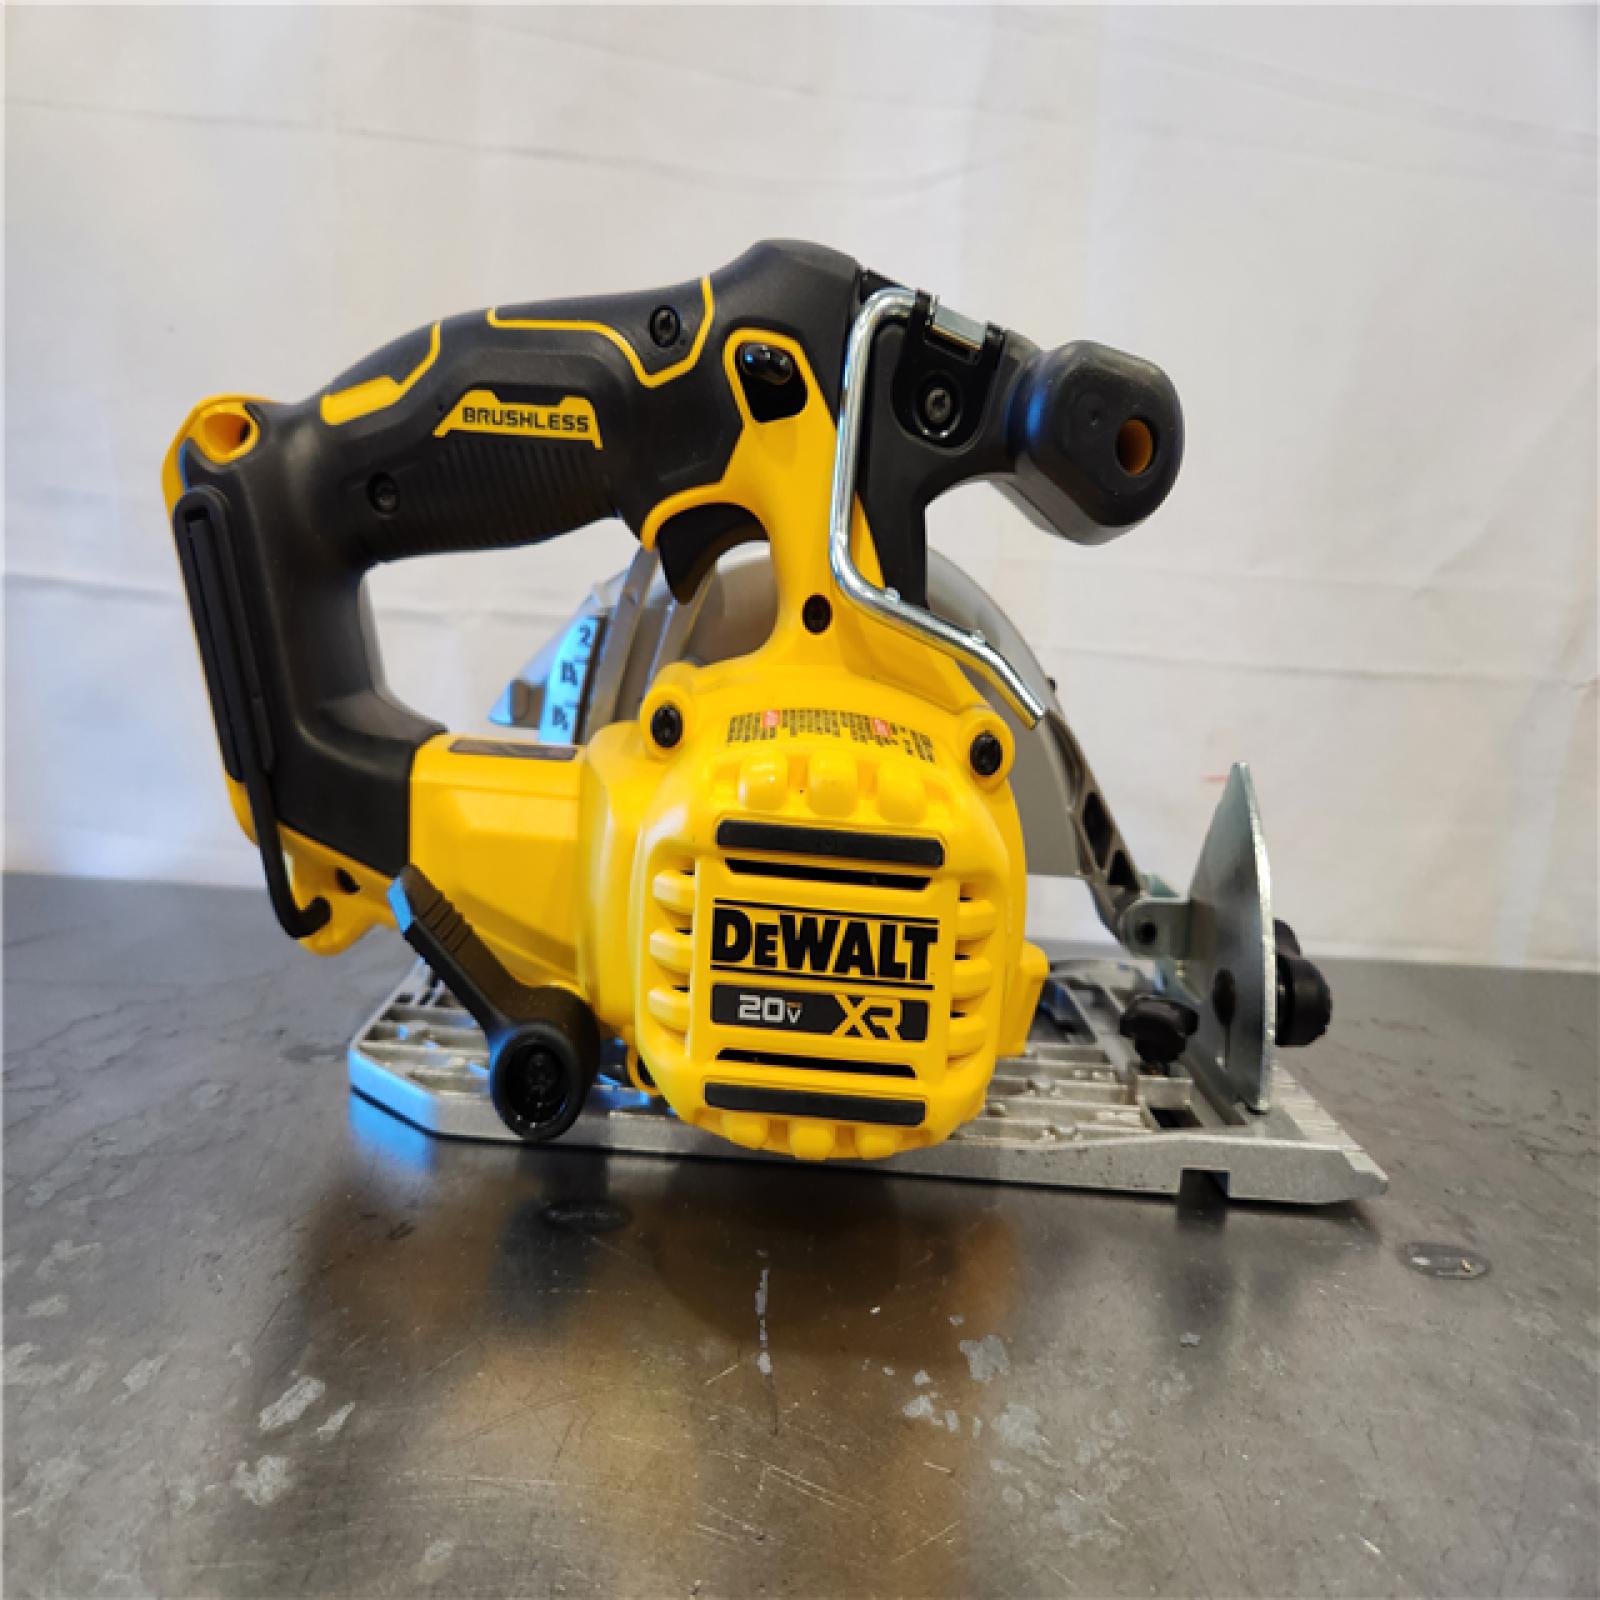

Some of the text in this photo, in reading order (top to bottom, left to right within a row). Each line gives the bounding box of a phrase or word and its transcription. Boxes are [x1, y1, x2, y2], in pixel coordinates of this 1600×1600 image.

[463, 407, 589, 432] BRUSHLESS
[712, 907, 938, 980] DEWALT
[832, 994, 901, 1040] XR
